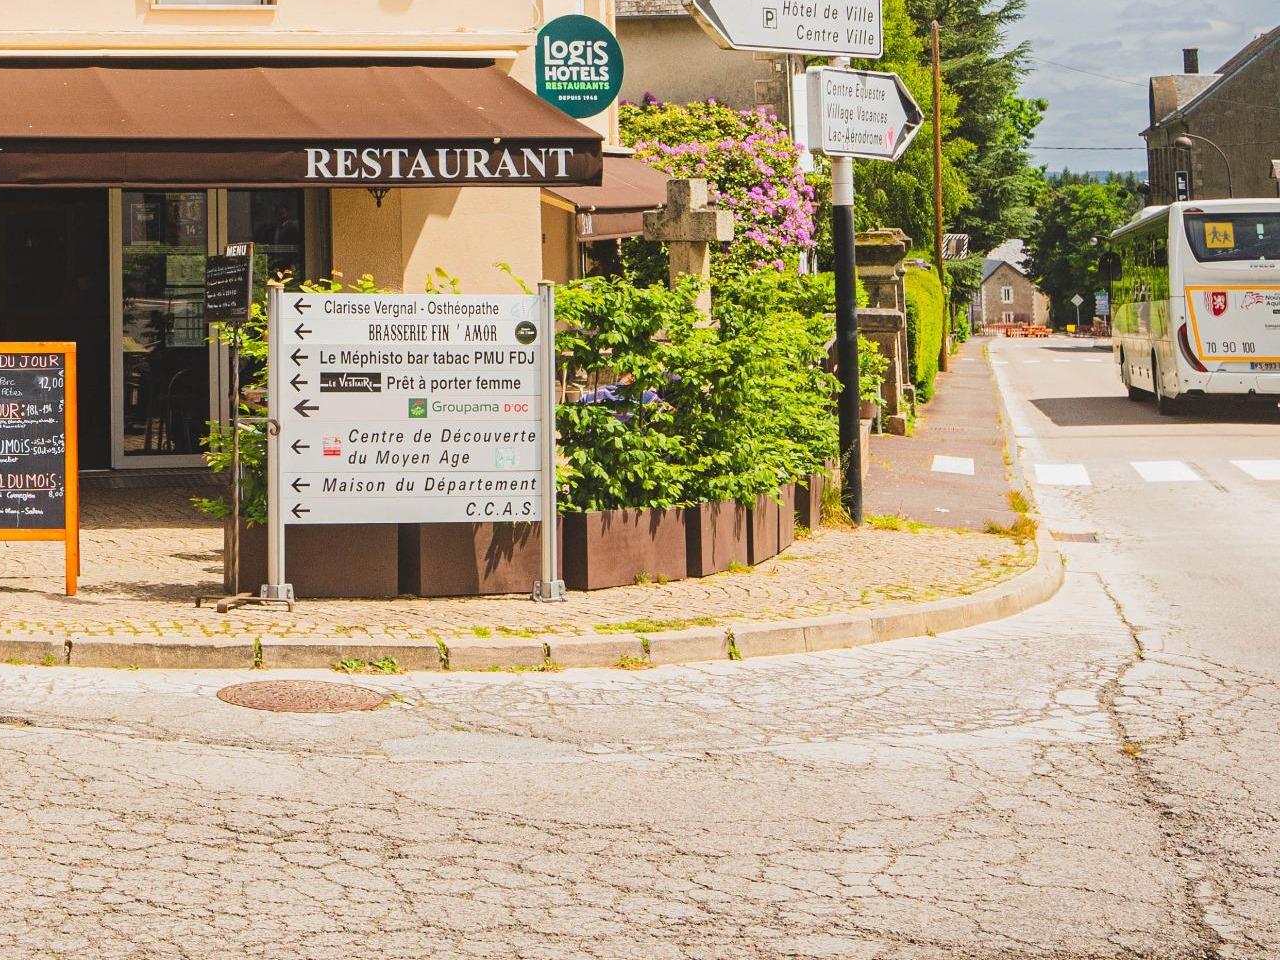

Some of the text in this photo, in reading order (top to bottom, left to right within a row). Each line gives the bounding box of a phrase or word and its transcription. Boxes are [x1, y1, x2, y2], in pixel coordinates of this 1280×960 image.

[783, 0, 874, 23] Hôtel de Ville
[796, 24, 874, 45] Centre Ville
[545, 66, 609, 81] HOTELS
[545, 82, 610, 90] RESTAURANTS
[826, 79, 886, 101] Centre Equestre
[826, 103, 888, 124] Village Vacances
[304, 147, 574, 180] RESTAURANT
[225, 244, 247, 257] MENU
[324, 300, 370, 315] Clarisse
[374, 300, 417, 318] Vergnal
[427, 300, 499, 318] Osthéopathe
[368, 324, 428, 342] BRASSERIE
[432, 324, 449, 342] FIN
[1206, 341, 1255, 353] 70 90 100
[0, 355, 15, 368] DU
[20, 354, 59, 368] JOUR
[320, 350, 535, 368] Le Méphisto bar tabac PMU FDJ
[387, 376, 415, 389] Prêt
[418, 376, 426, 389] à
[430, 377, 472, 392] porter
[476, 376, 521, 390] femme
[432, 401, 499, 414] Groupama
[348, 428, 536, 443] Centre de Découverte
[348, 450, 470, 467] du Moyen Age
[8, 473, 23, 488] DU
[322, 477, 536, 494] Maison du Département
[466, 501, 536, 516] C.C.A.S.
